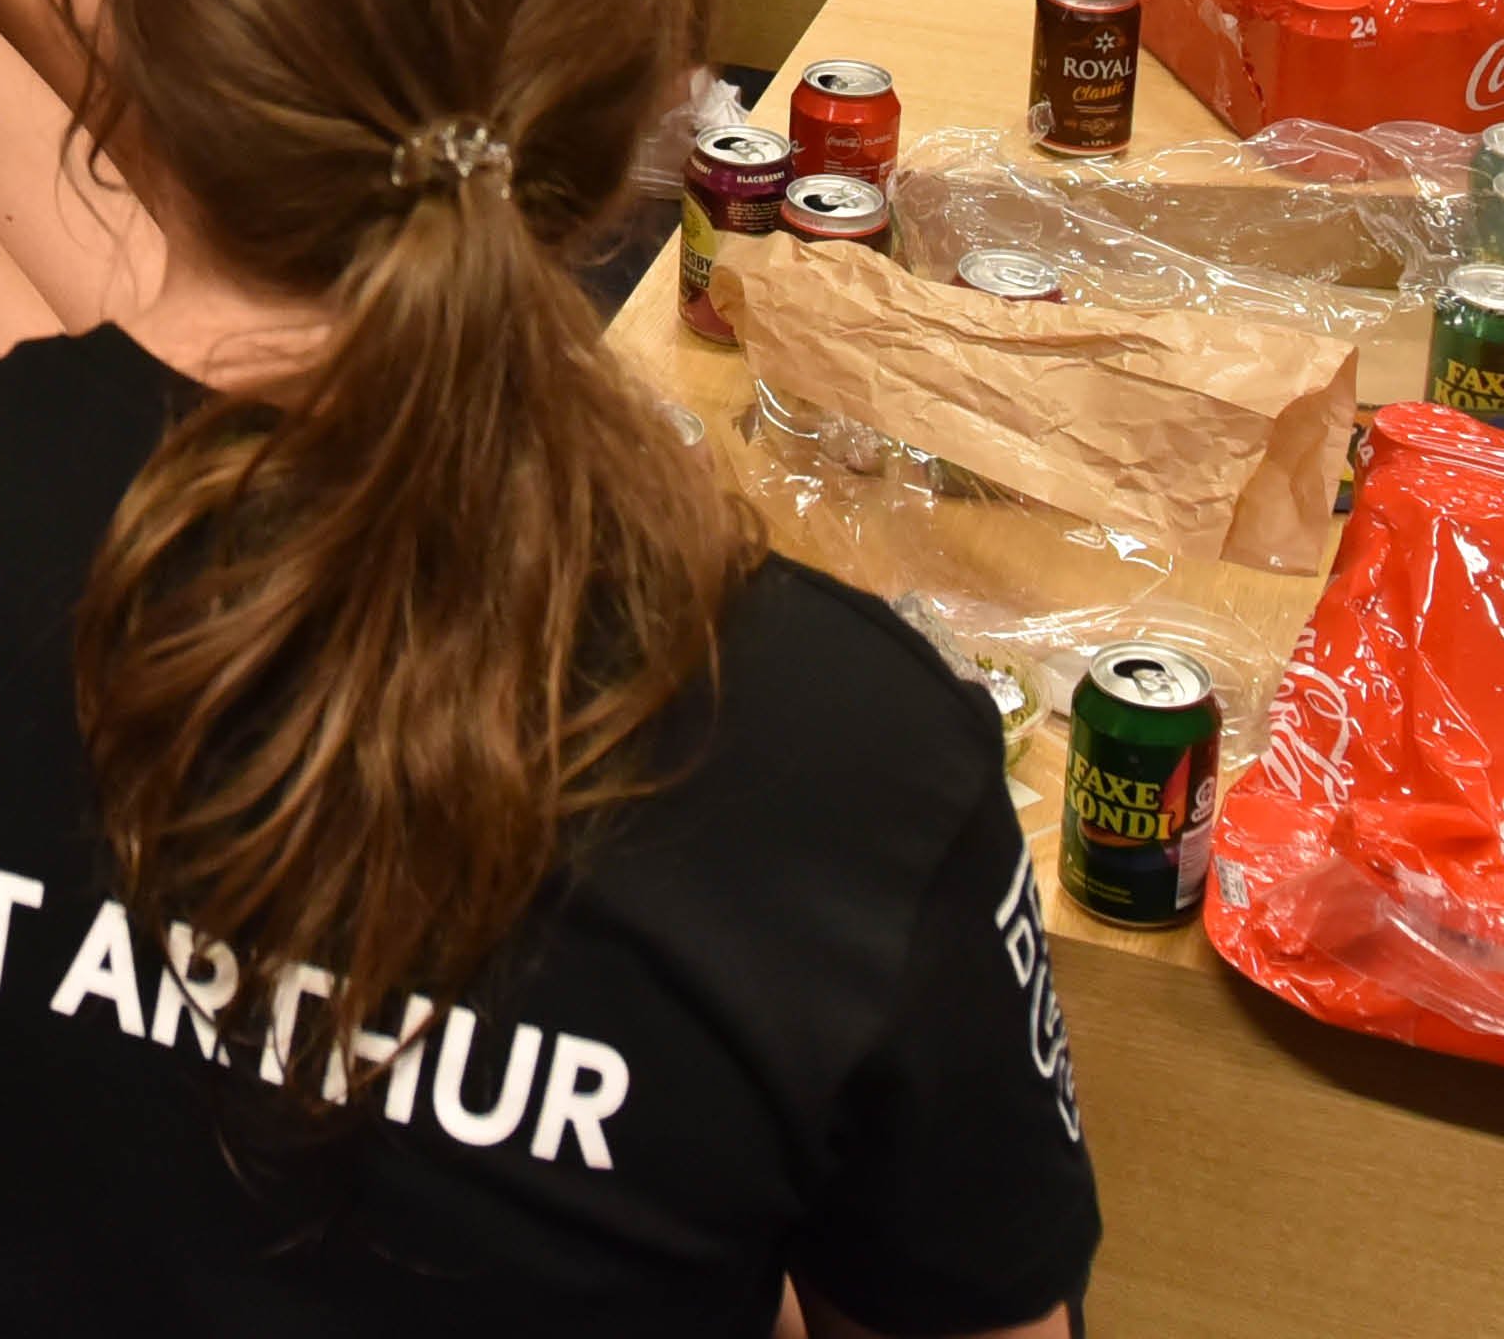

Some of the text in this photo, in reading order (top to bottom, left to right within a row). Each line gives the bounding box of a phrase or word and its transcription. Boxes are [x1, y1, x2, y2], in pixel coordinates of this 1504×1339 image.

[1349, 15, 1378, 40] 24
[1062, 55, 1134, 81] ROYAL
[1072, 80, 1128, 102] Classic
[736, 169, 786, 185] BLACKBERRY
[1072, 750, 1161, 810] FAXE
[50, 901, 631, 1170] ARTHUR
